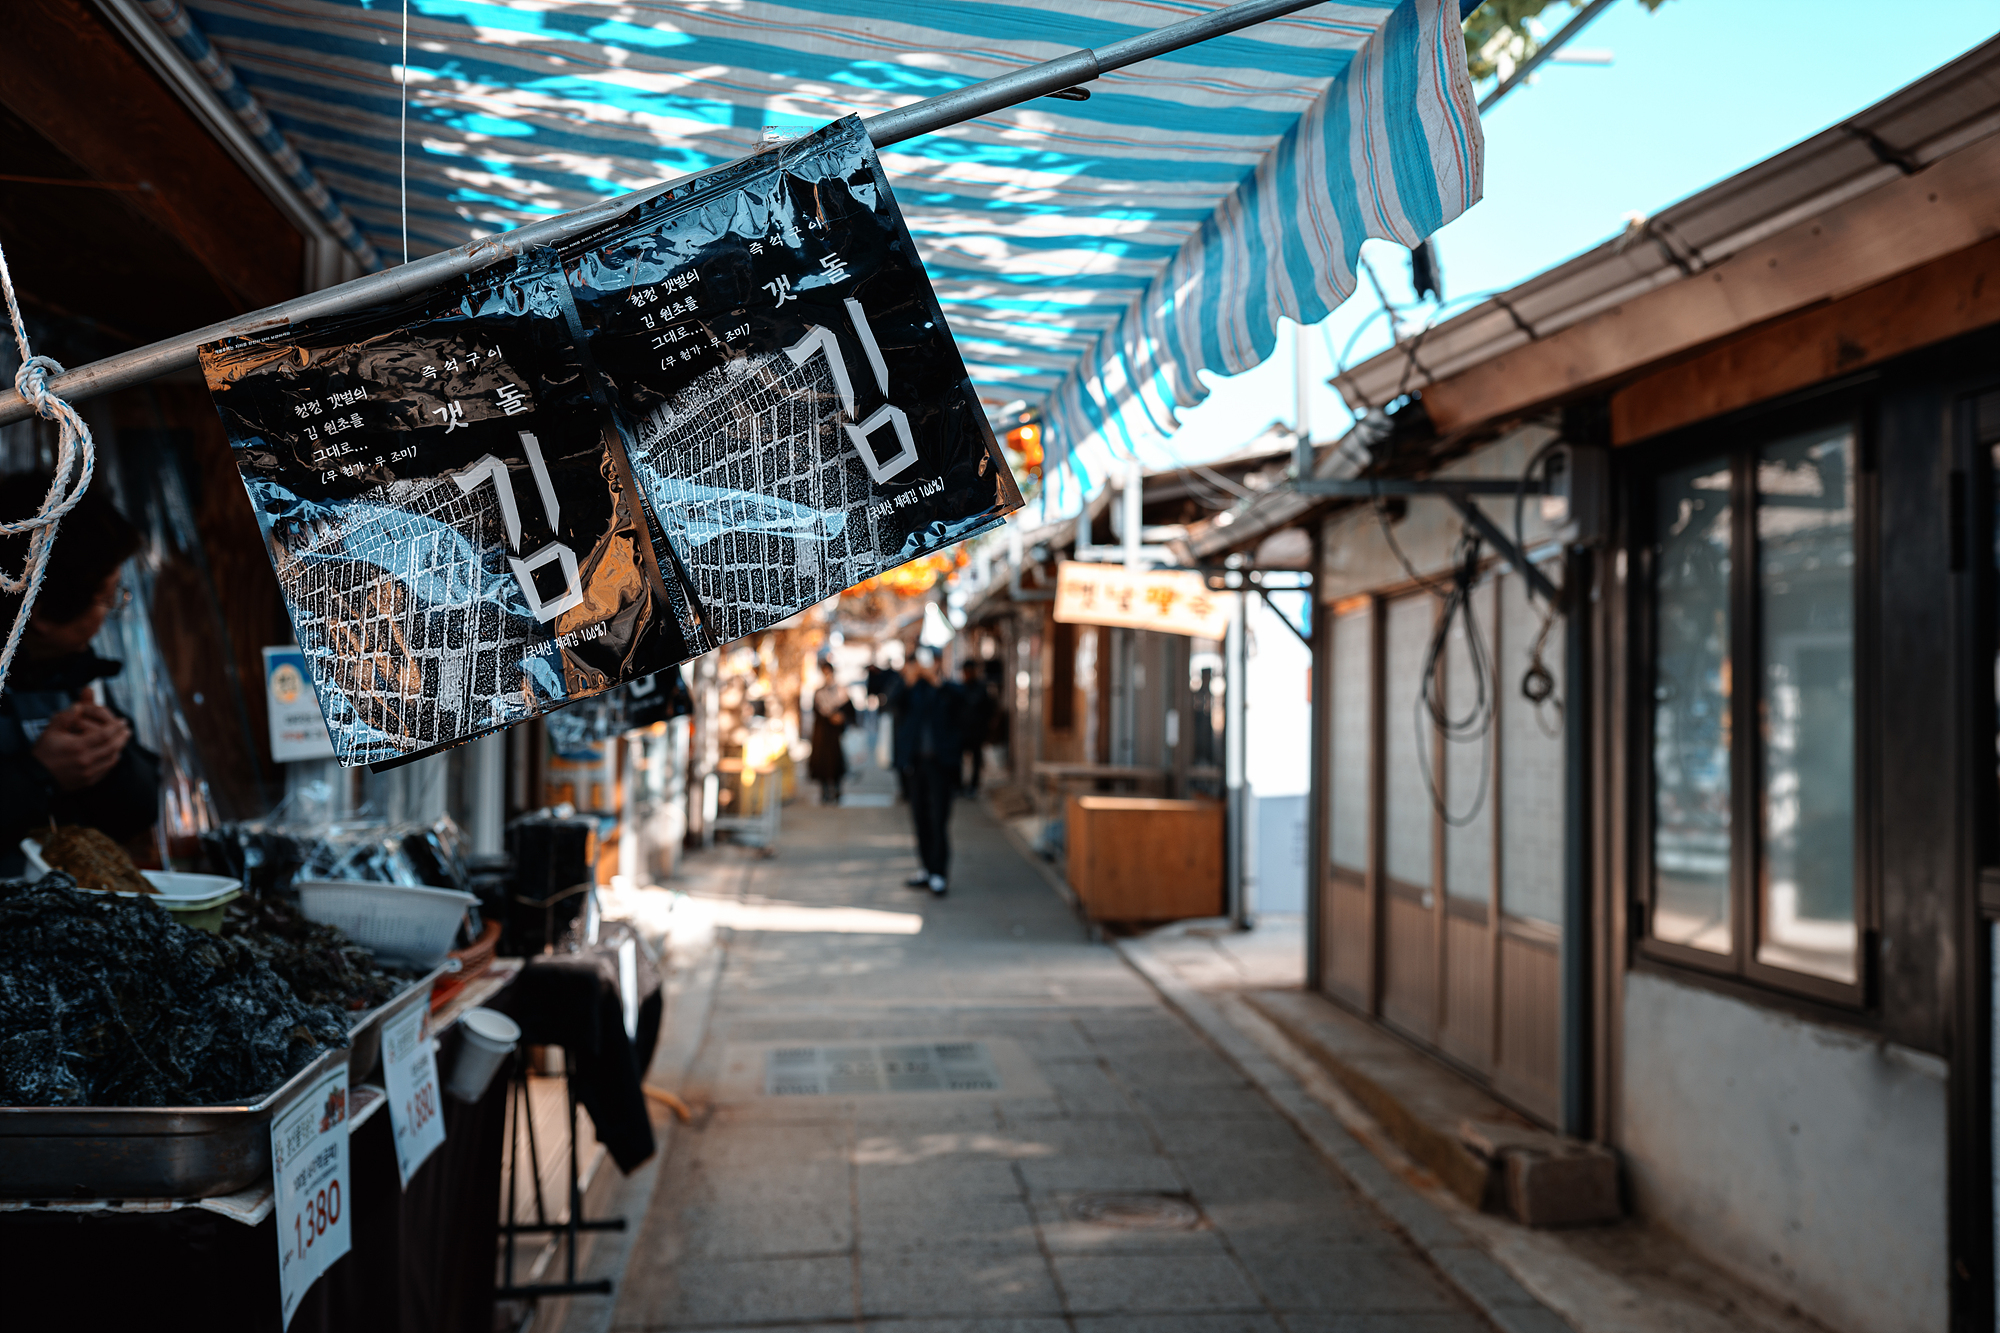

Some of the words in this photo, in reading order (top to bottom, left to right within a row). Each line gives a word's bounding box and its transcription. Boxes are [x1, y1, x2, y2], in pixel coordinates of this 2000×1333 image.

[630, 287, 658, 307] 청정
[661, 268, 700, 295] 갯벌의
[640, 313, 656, 329] 김
[660, 295, 699, 321] 원초를
[651, 326, 703, 350] 그대로...
[294, 400, 323, 419] 청정
[327, 386, 368, 410] 갯벌의
[782, 297, 918, 485] 김
[303, 425, 318, 441] 김
[324, 413, 364, 435] 원초를
[313, 442, 368, 462] 그대로...
[895, 492, 919, 509] 재래김
[452, 430, 584, 624] 김
[555, 632, 579, 650] 재래김
[295, 1179, 341, 1260] 1,380
